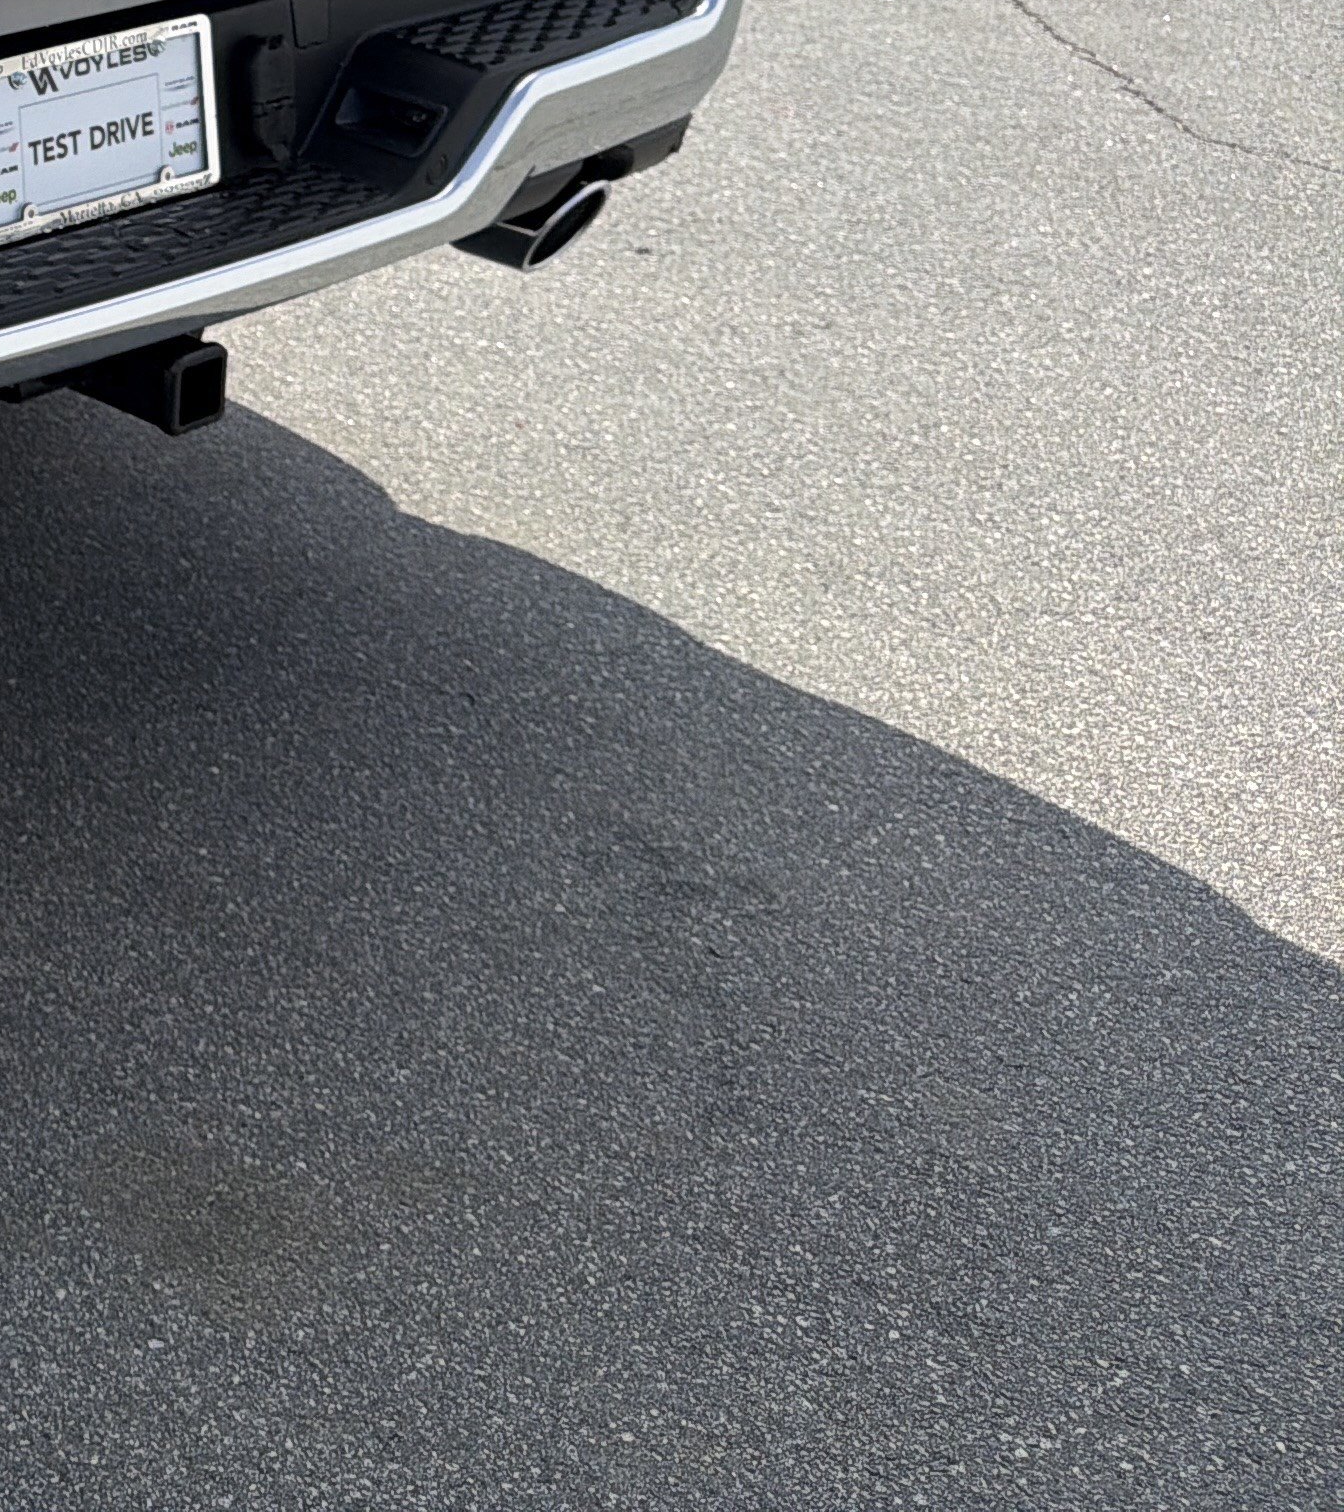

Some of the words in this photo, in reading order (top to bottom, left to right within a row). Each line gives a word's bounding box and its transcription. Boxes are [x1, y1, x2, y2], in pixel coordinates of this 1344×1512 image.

[59, 44, 148, 80] VOYLES
[28, 129, 81, 165] TEST
[89, 111, 154, 150] DRIVE
[169, 141, 197, 157] Jeep
